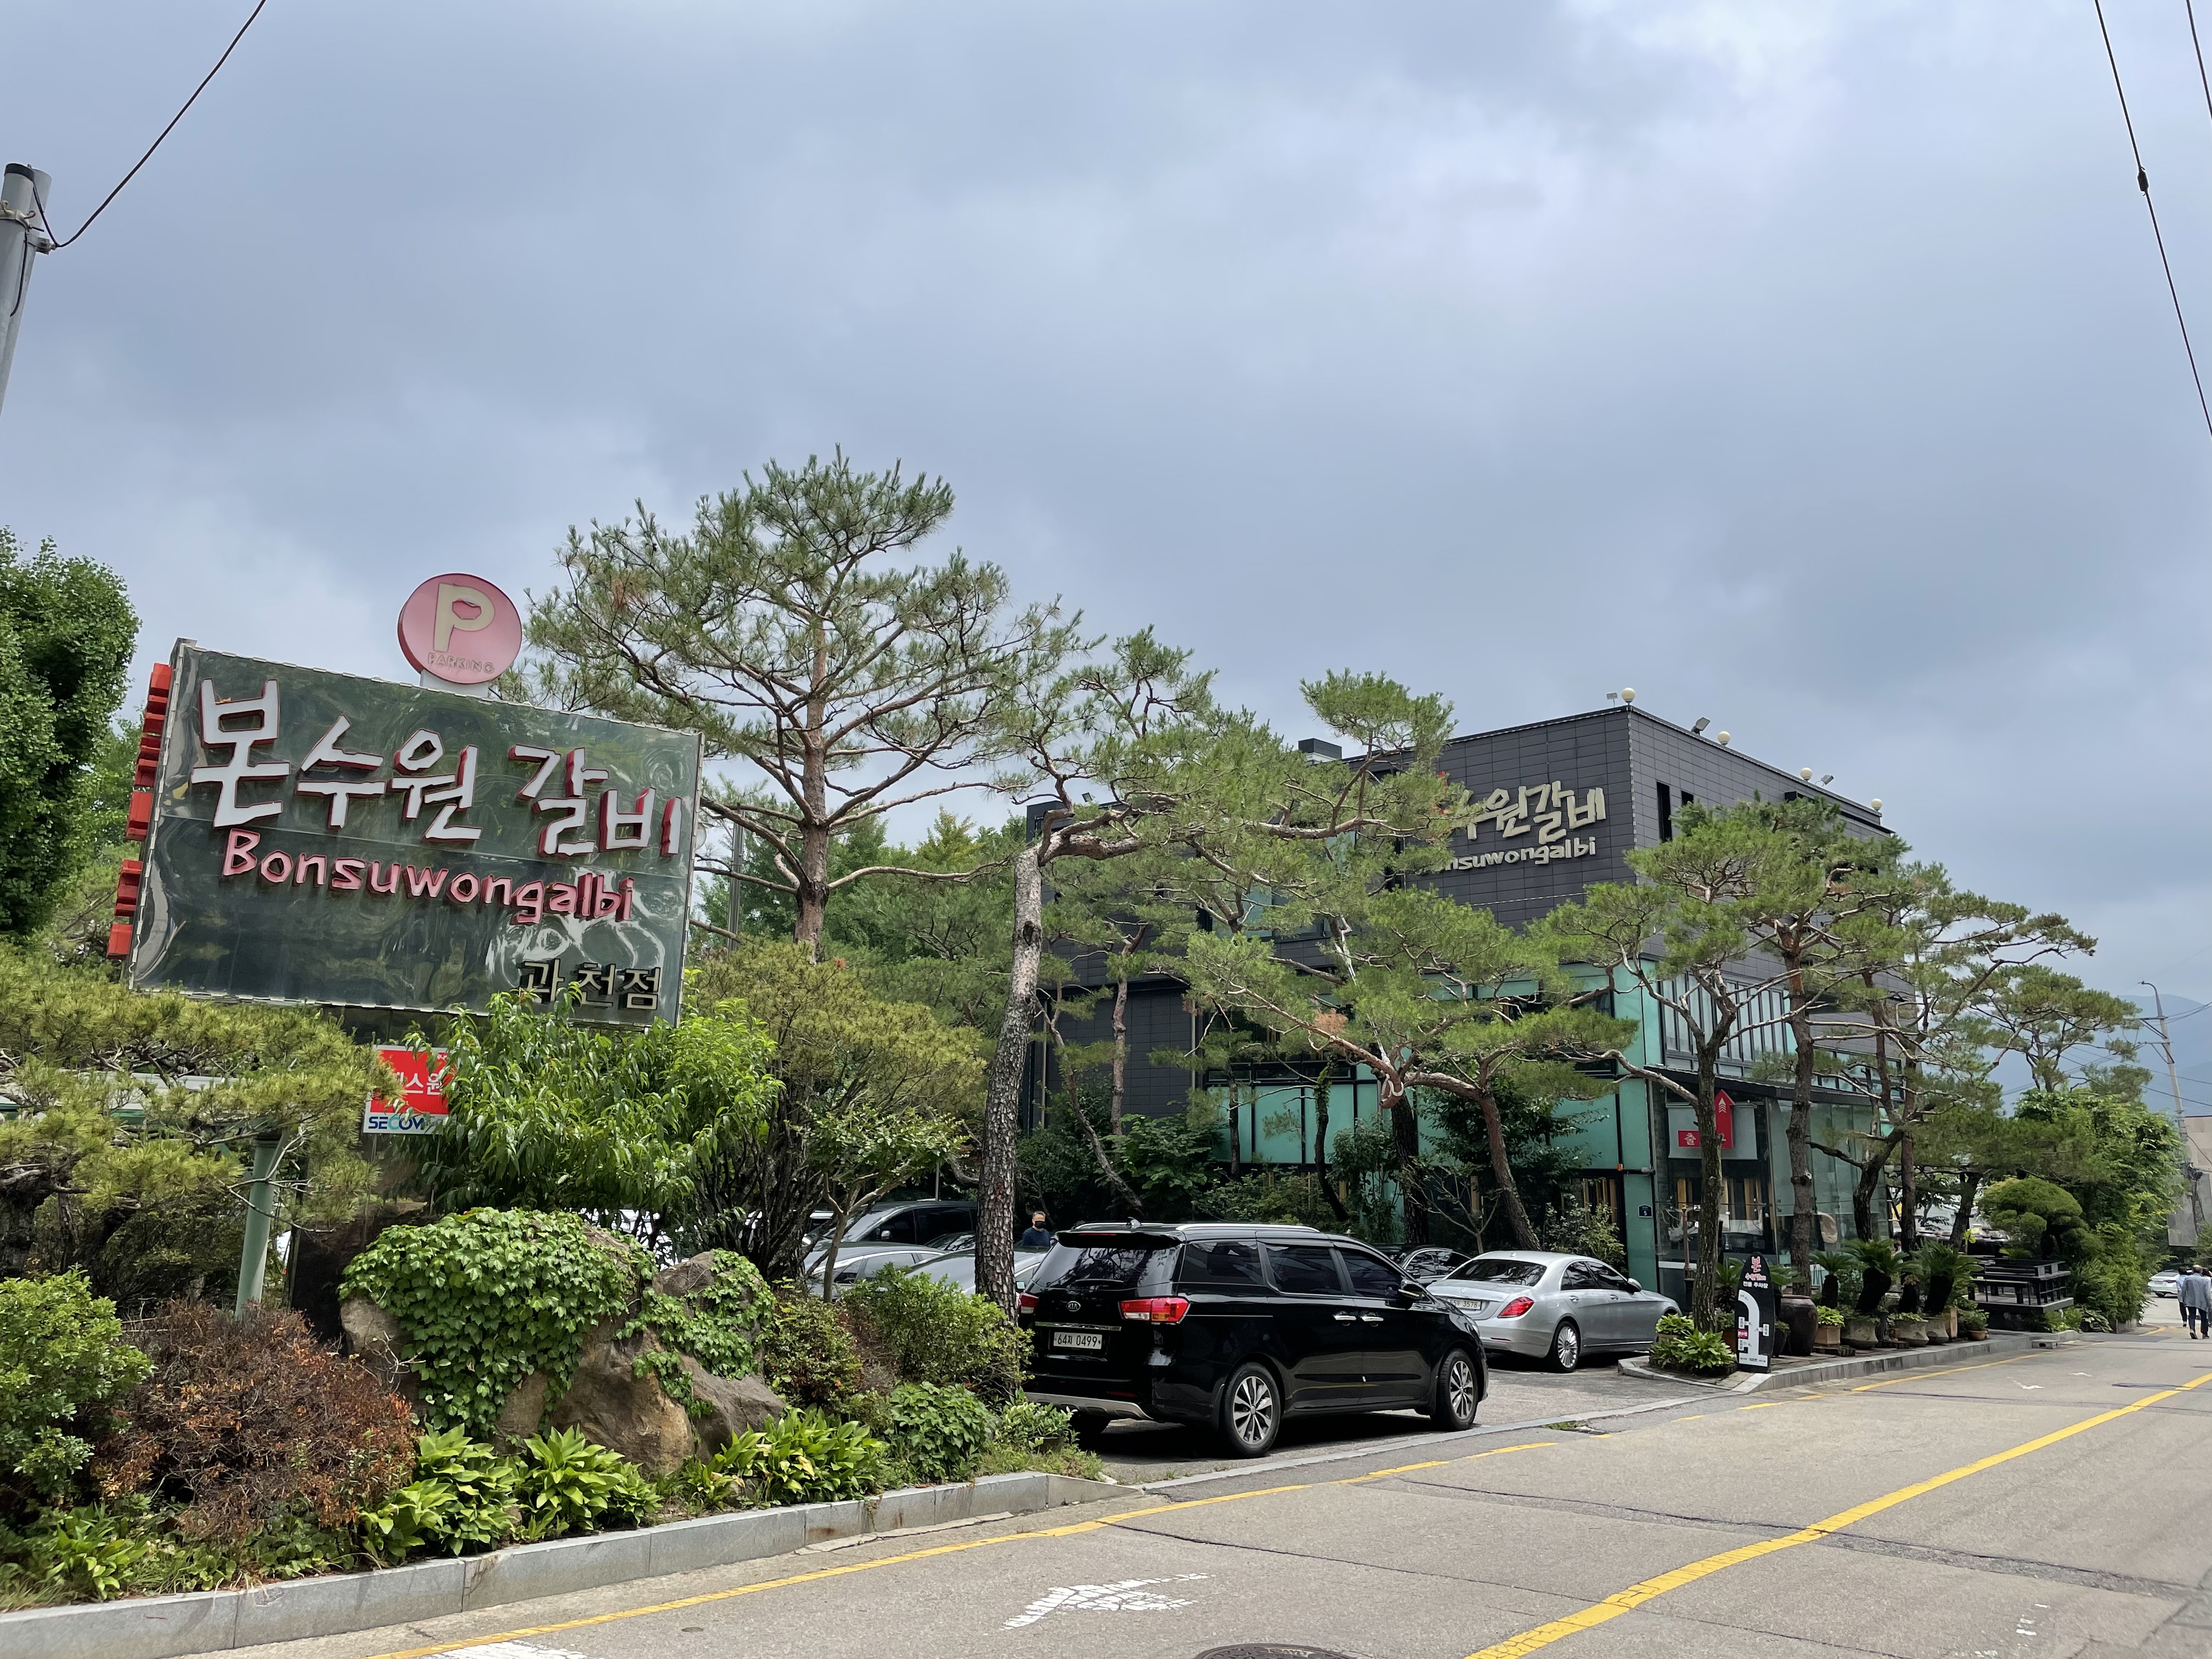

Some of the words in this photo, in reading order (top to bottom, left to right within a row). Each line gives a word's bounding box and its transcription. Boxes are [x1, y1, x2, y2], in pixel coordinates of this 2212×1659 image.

[433, 583, 495, 653] P
[427, 652, 495, 674] PARKING
[191, 679, 482, 843] 본수원
[509, 744, 682, 858] 갈비
[1444, 837, 1596, 871] nsuwongalbi
[222, 828, 634, 925] Bonsuwongalbi
[517, 958, 661, 1011] 과천점
[1751, 1256, 1762, 1273] 본
[1076, 1335, 1098, 1347] 0499
